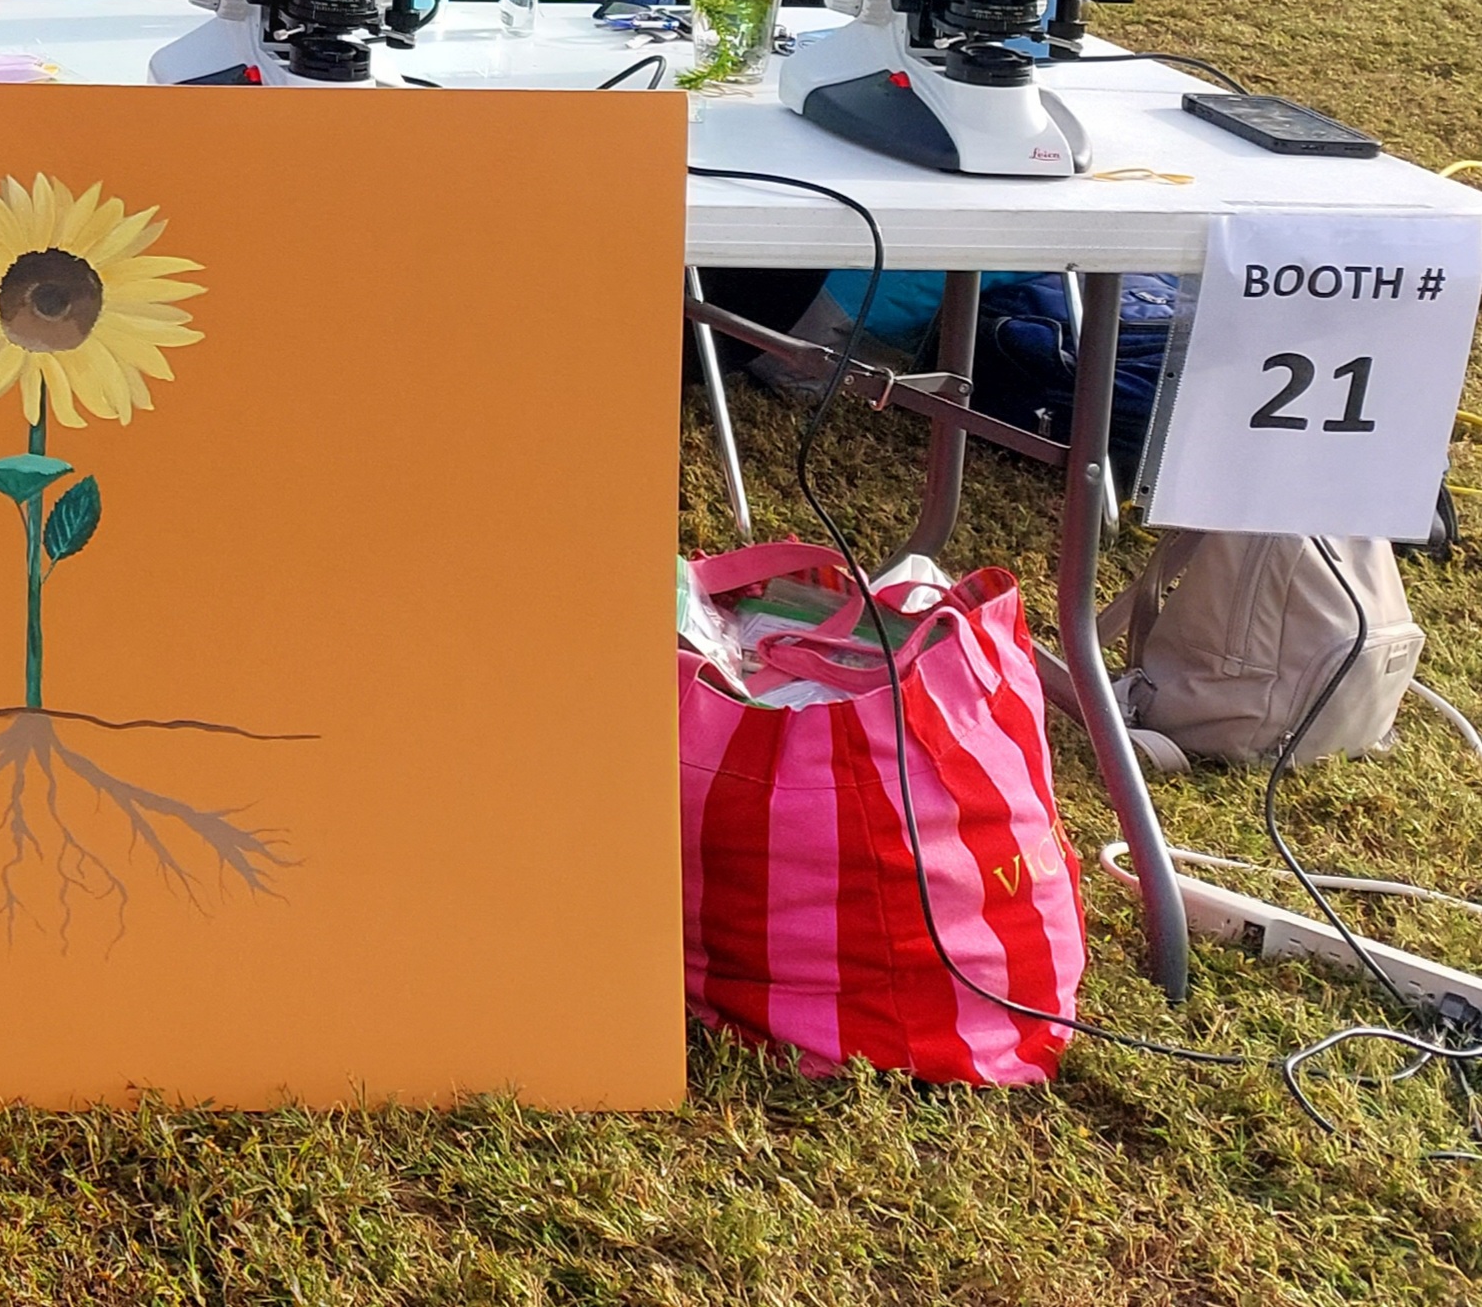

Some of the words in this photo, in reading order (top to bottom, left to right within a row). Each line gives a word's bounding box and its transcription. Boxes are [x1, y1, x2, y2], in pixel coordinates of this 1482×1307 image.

[1243, 264, 1404, 299] BOOTH
[1417, 267, 1445, 301] #
[1249, 352, 1376, 433] 21
